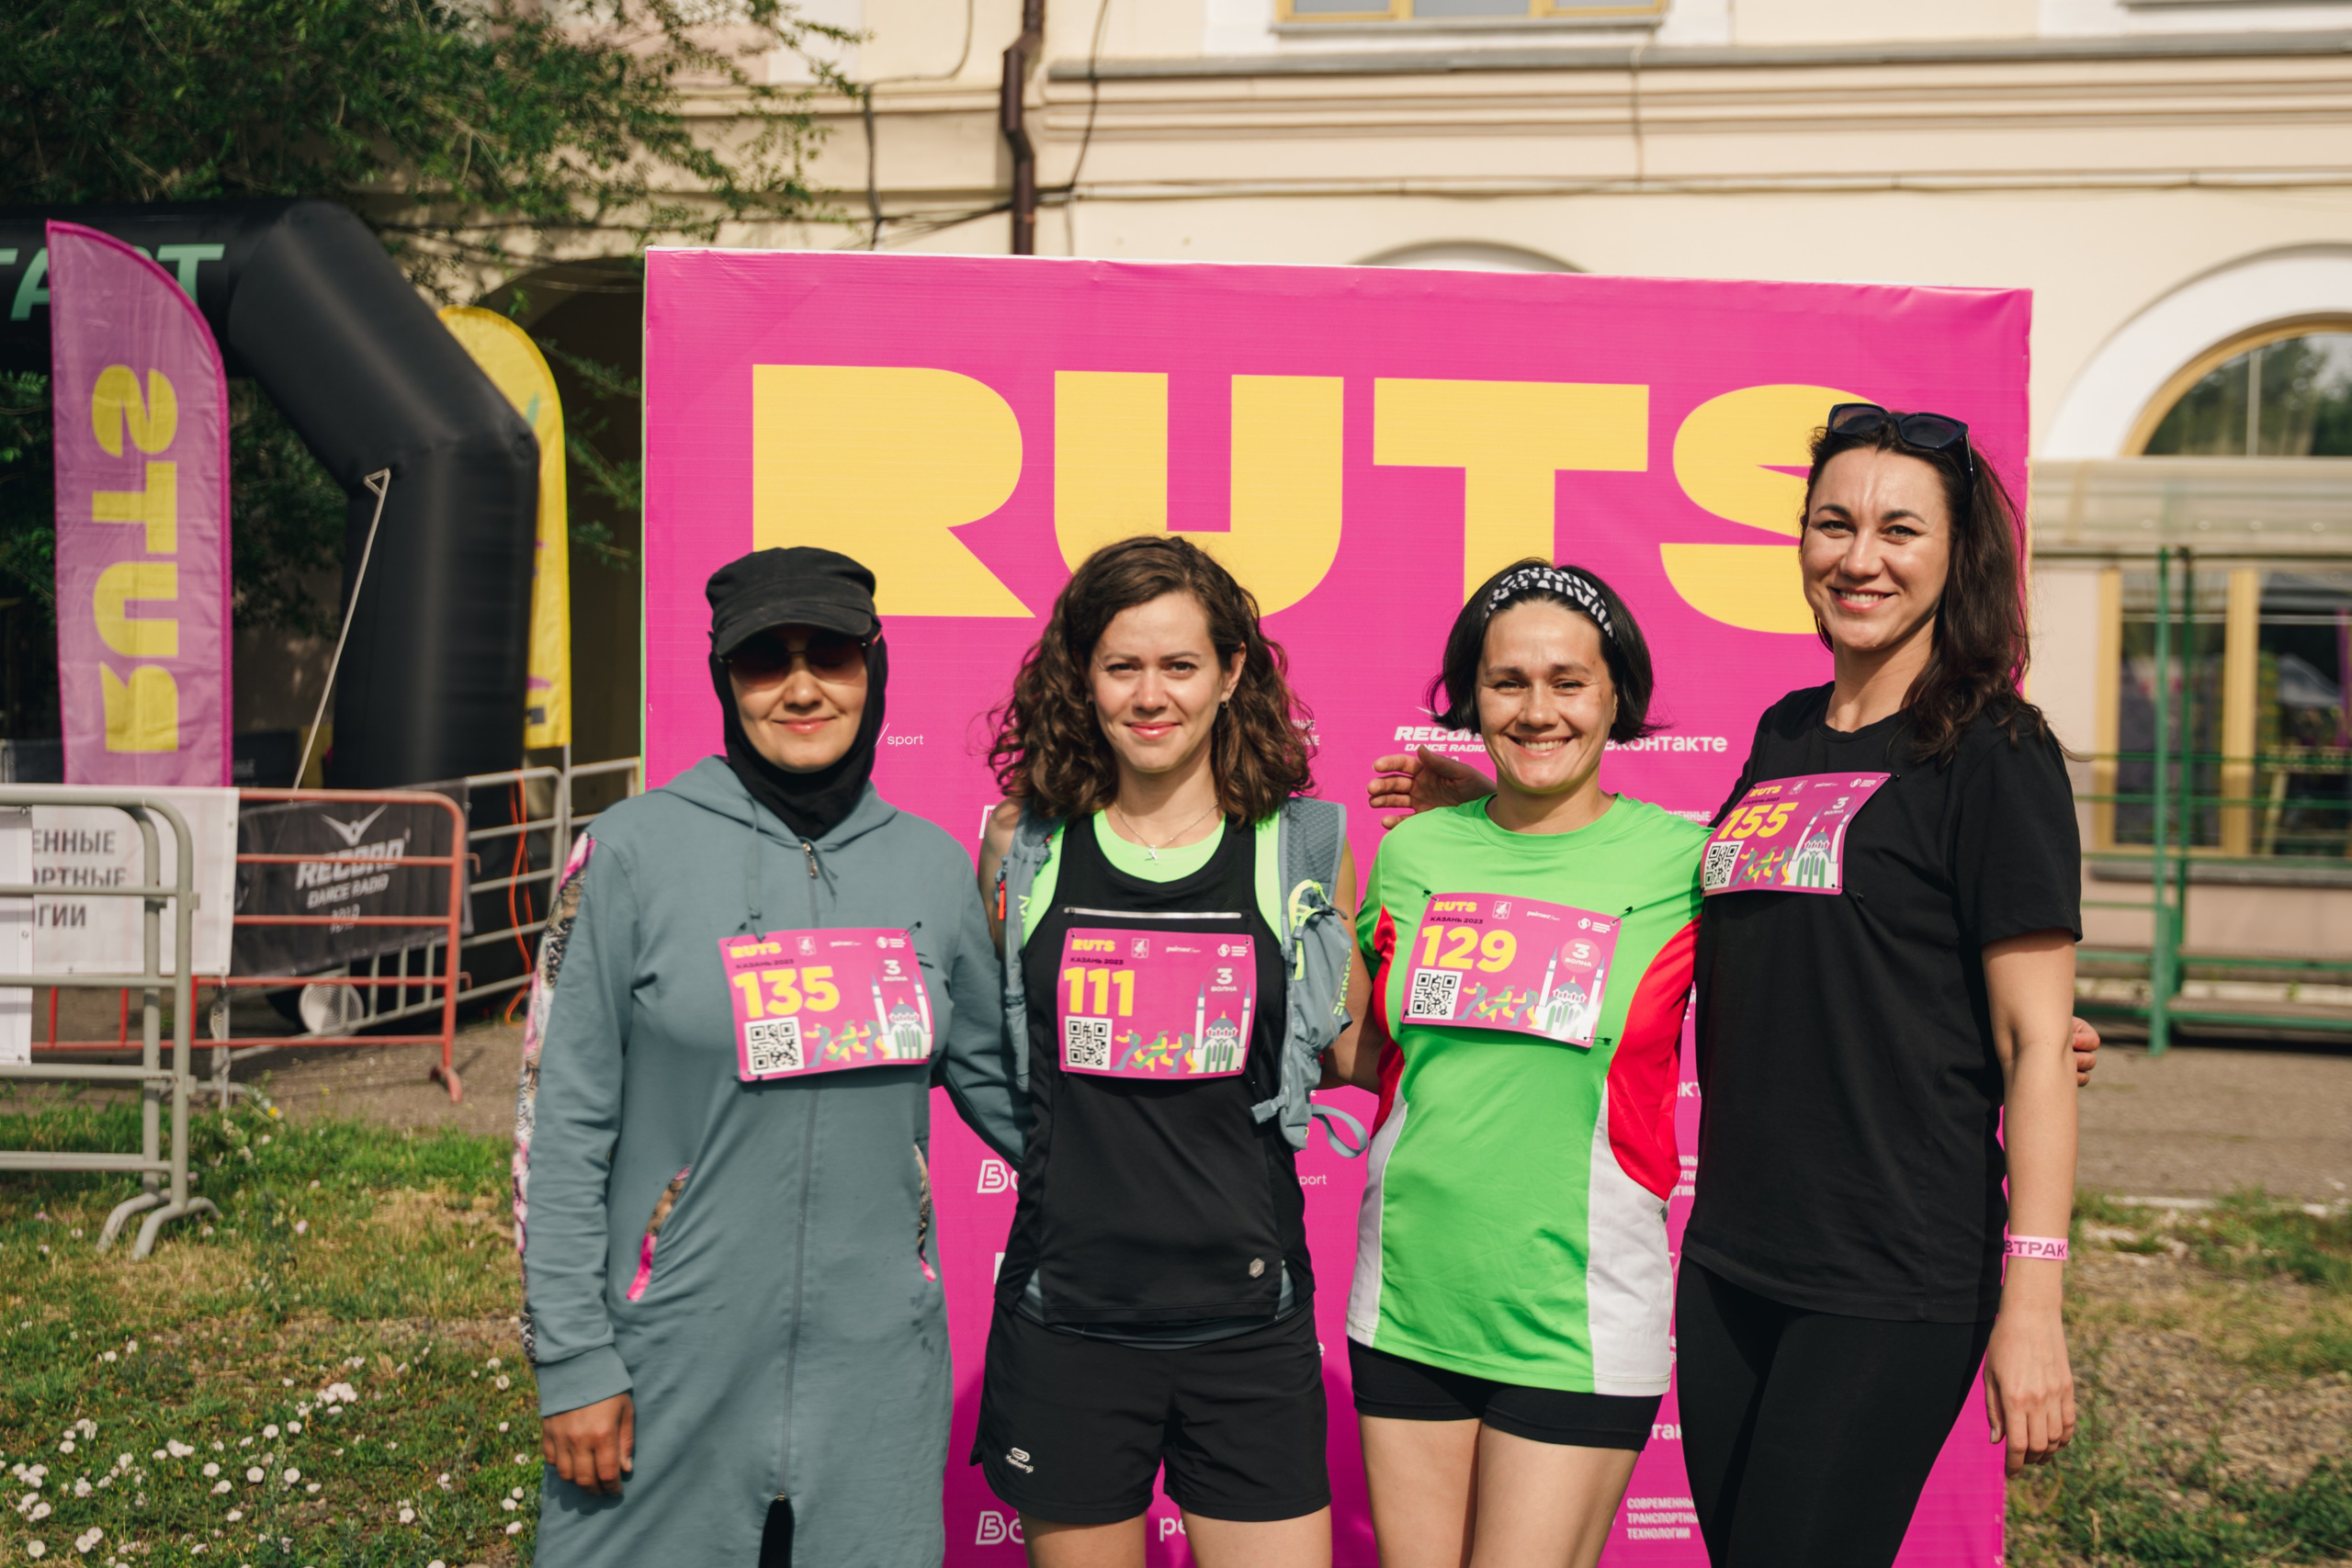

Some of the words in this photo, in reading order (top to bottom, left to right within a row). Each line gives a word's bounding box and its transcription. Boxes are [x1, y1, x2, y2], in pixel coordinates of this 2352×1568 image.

[752, 364, 1885, 634] RUTS
[887, 735, 924, 747] sport
[1449, 744, 1487, 752] RADIO
[1749, 785, 1782, 797] RUTS
[1832, 796, 1849, 809] 3
[1717, 802, 1799, 840] 155
[33, 866, 127, 886] РТНЫЕ
[307, 882, 350, 909] DANCE
[352, 873, 390, 897] RADIO
[1433, 900, 1477, 913] RUTS
[33, 904, 86, 928] ГИИ
[730, 942, 782, 958] RUTS
[1071, 939, 1116, 953] RUTS
[1421, 925, 1517, 974] 129
[1572, 942, 1590, 959] 3
[883, 959, 901, 975] 3
[1070, 956, 1102, 964] КАЗАНЬ
[1565, 957, 1592, 967] ВОЛНА
[1216, 967, 1233, 985] 3
[732, 965, 841, 1019] 135
[1064, 966, 1136, 1017] 111
[1626, 1497, 1694, 1509] СОВРЕМЕННЫ
[1626, 1512, 1699, 1525] ТРАНСПОРТНЫ
[1626, 1527, 1690, 1540] ТЕХНОЛОГИИ
